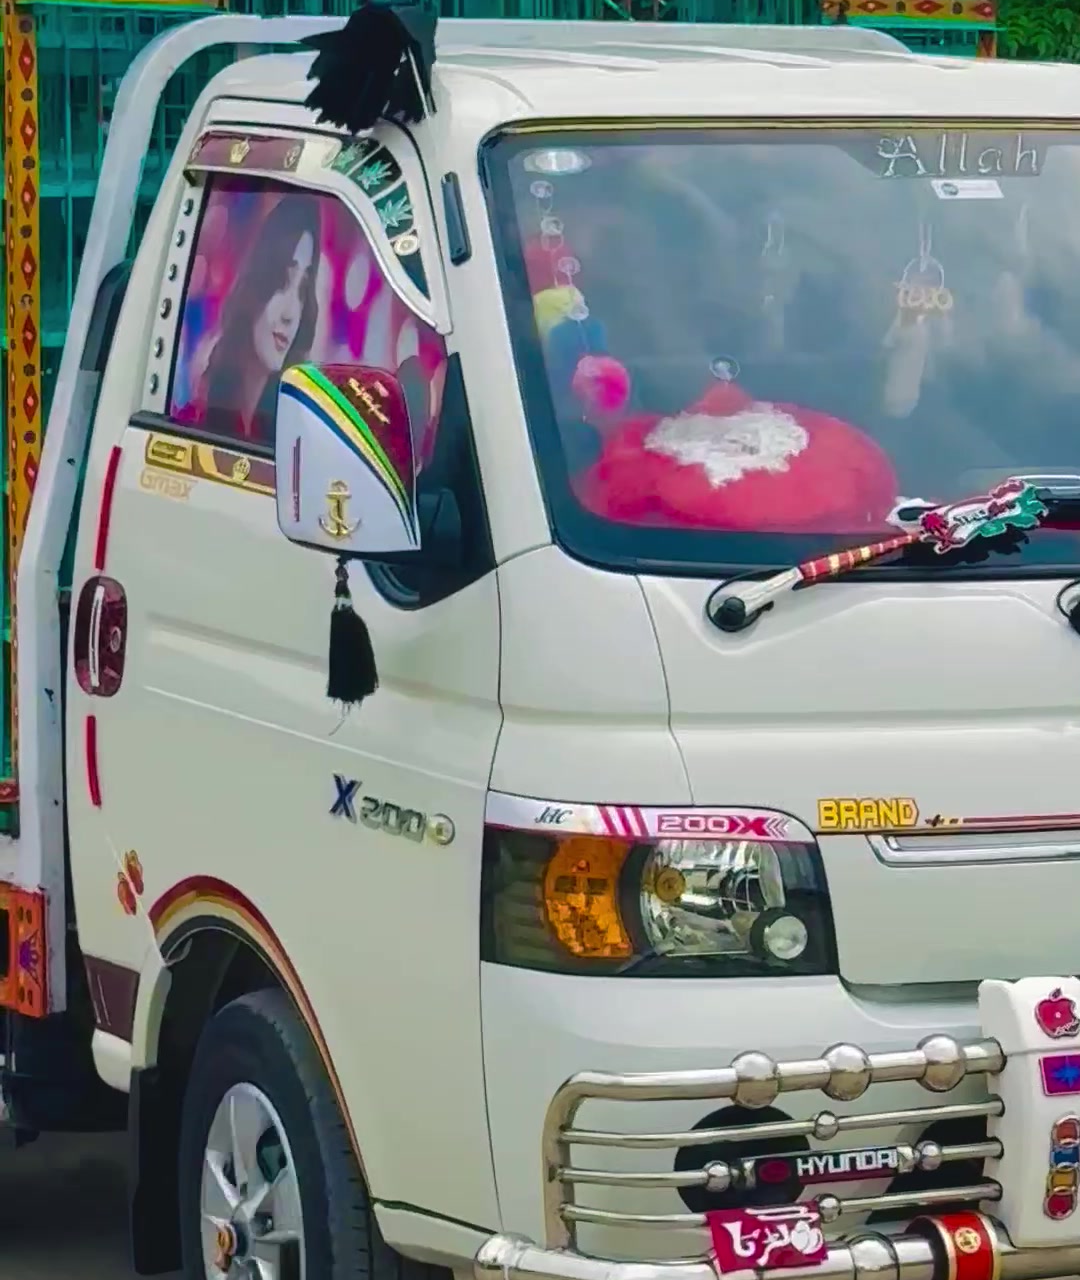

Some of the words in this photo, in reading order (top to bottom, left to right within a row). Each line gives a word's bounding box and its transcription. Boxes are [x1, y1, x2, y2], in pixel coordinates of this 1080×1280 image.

[659, 814, 769, 837] 200X
[817, 798, 919, 829] BRAND
[797, 1148, 898, 1177] HYUNDAI
